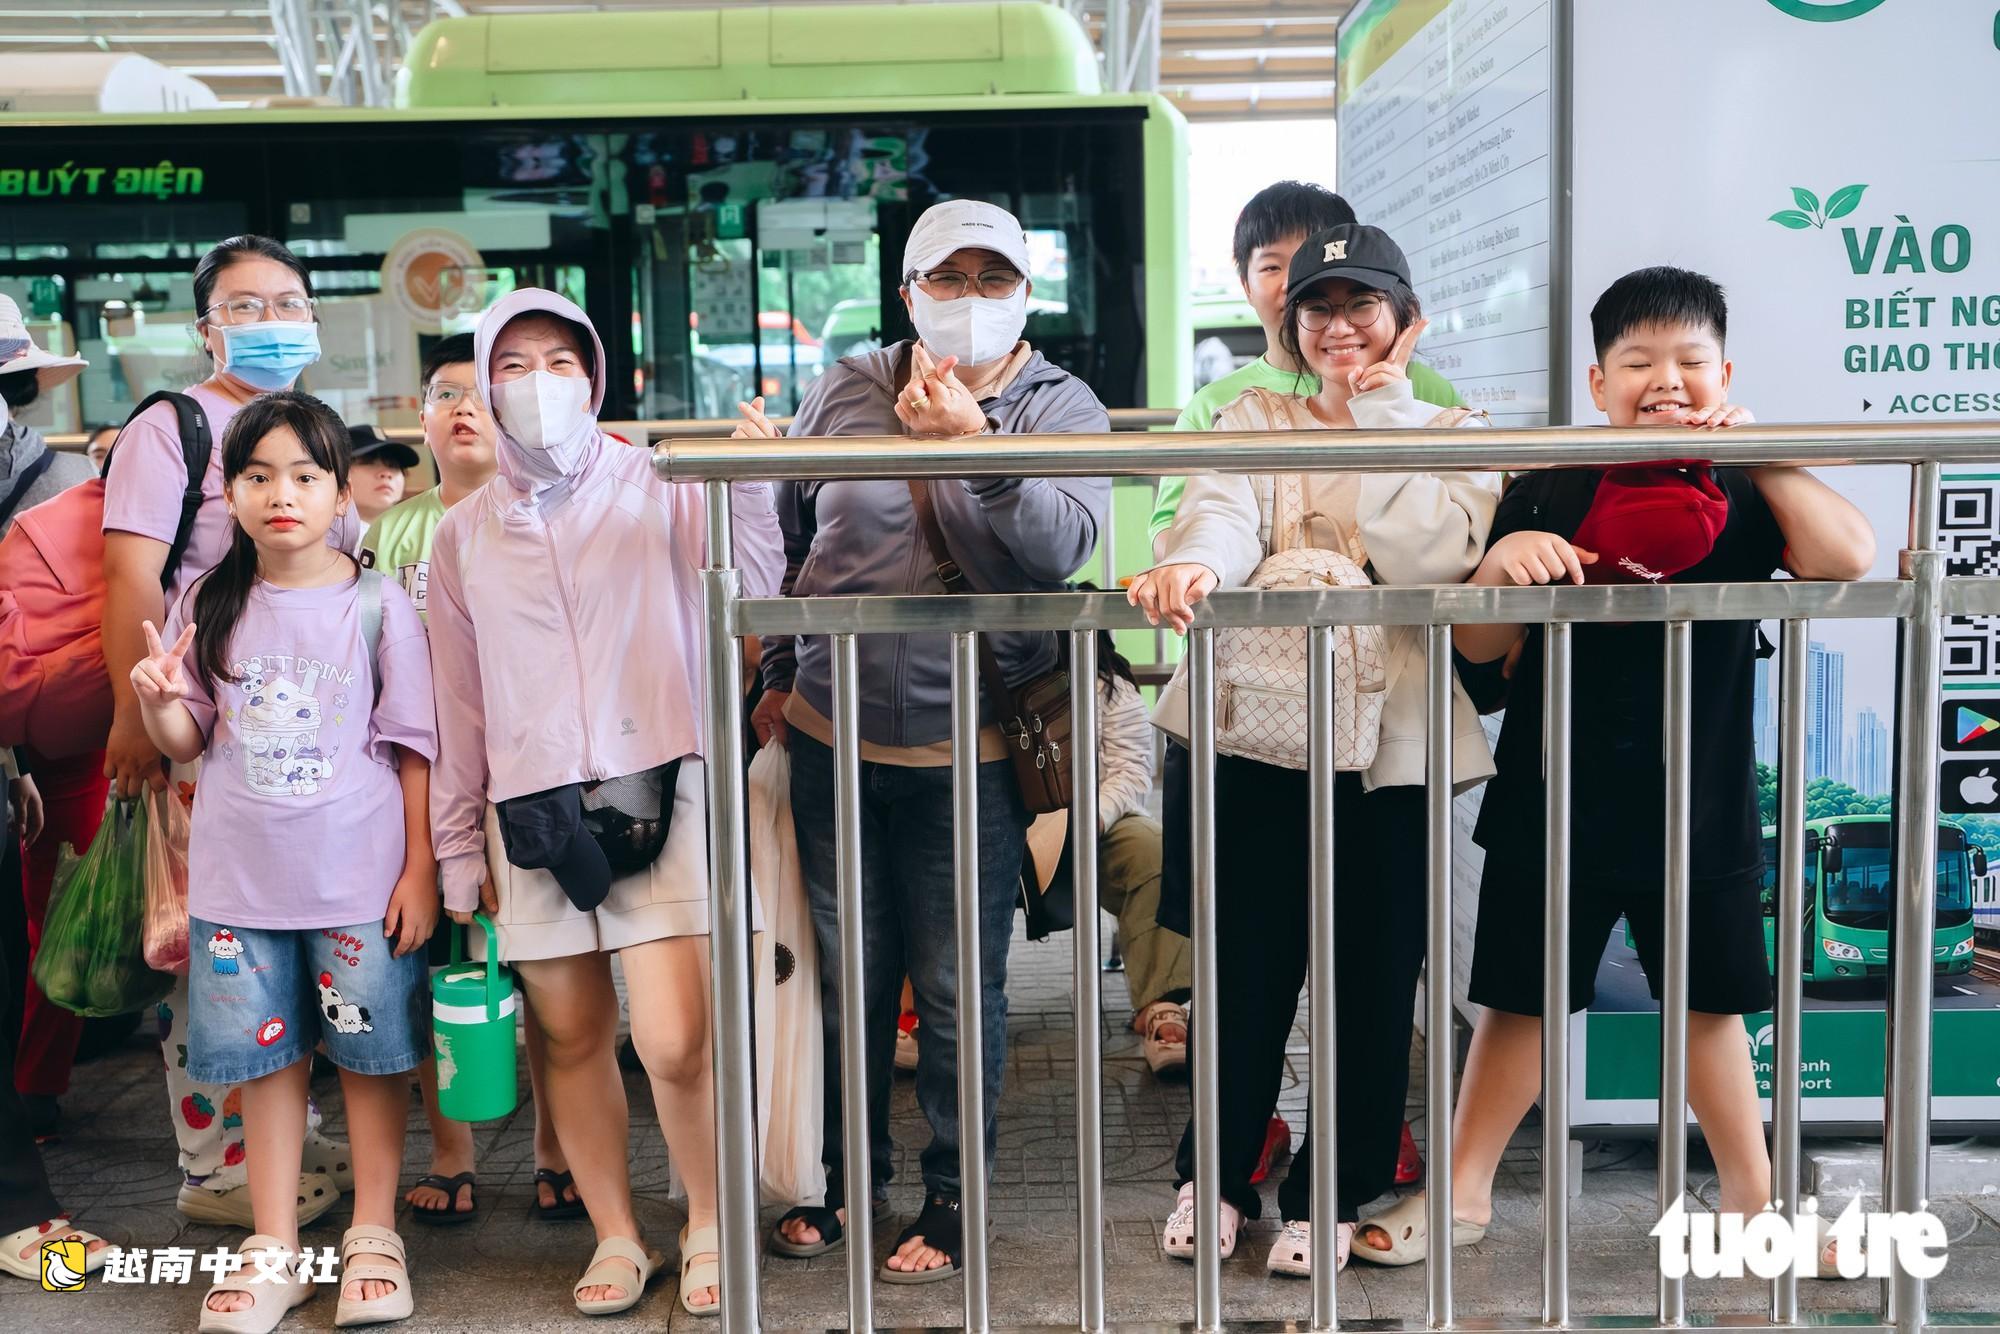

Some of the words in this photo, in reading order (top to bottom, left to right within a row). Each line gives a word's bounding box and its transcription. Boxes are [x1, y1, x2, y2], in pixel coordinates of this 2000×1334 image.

[0, 160, 106, 196] BUÝT
[1323, 240, 1347, 263] N
[1841, 214, 1971, 274] VÀO
[1846, 287, 1936, 329] BIẾT
[1844, 343, 1930, 373] GIAO
[1944, 340, 2000, 371] TH
